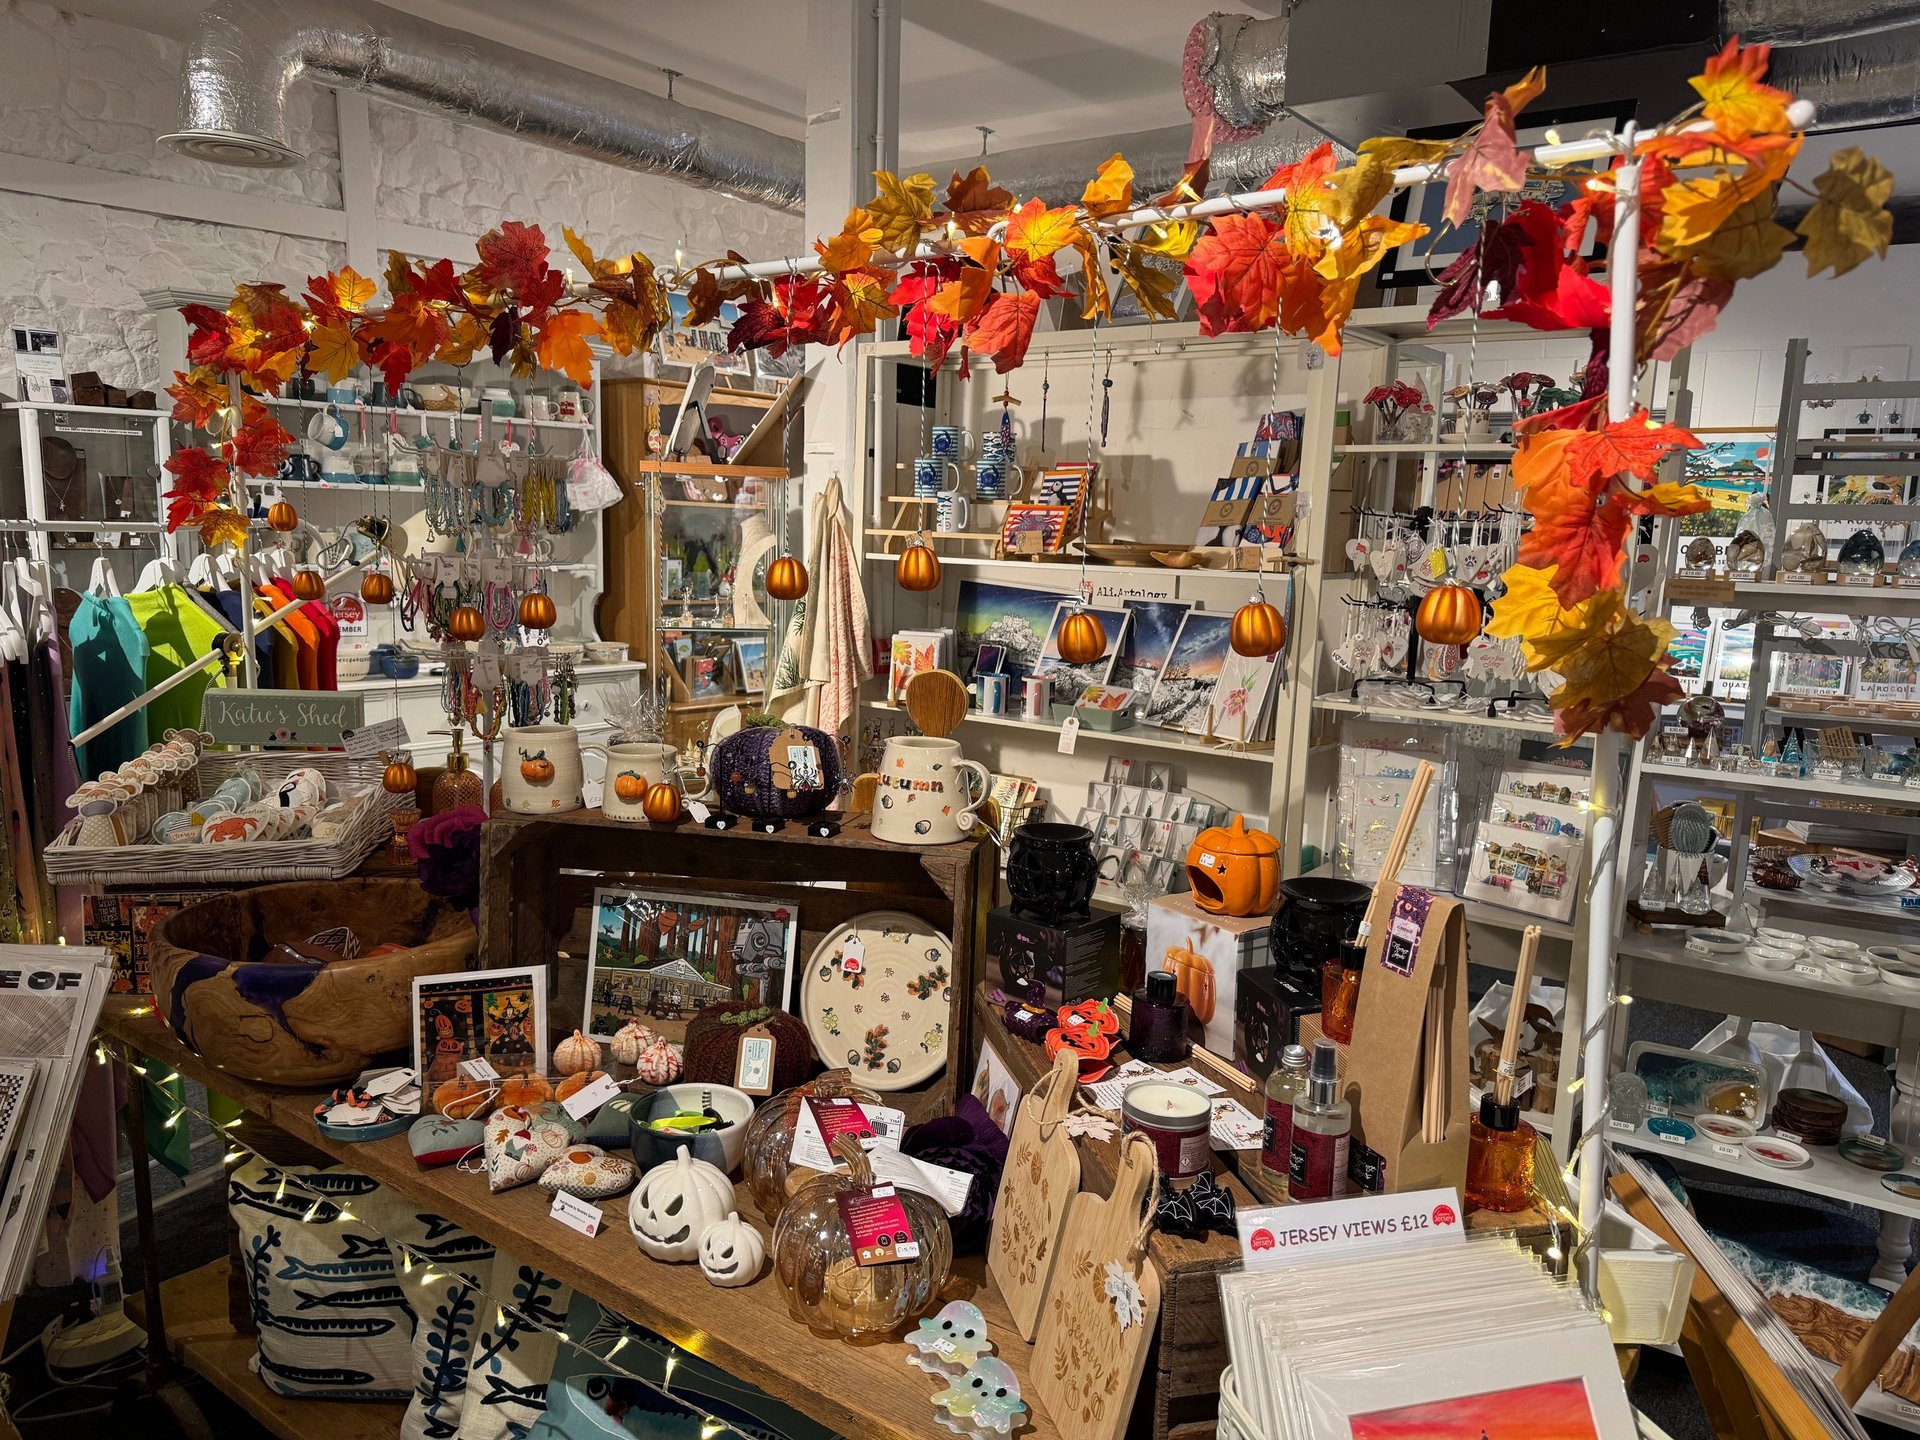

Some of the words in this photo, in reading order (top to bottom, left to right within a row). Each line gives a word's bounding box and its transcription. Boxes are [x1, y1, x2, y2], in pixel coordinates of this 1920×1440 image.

[218, 700, 289, 727] Katie's
[297, 702, 348, 728] Shed
[85, 931, 130, 945] SEASON
[28, 971, 82, 990] OF
[1279, 1225, 1338, 1247] JERSEY
[1343, 1219, 1397, 1238] VIEWS
[1401, 1214, 1429, 1232] £12
